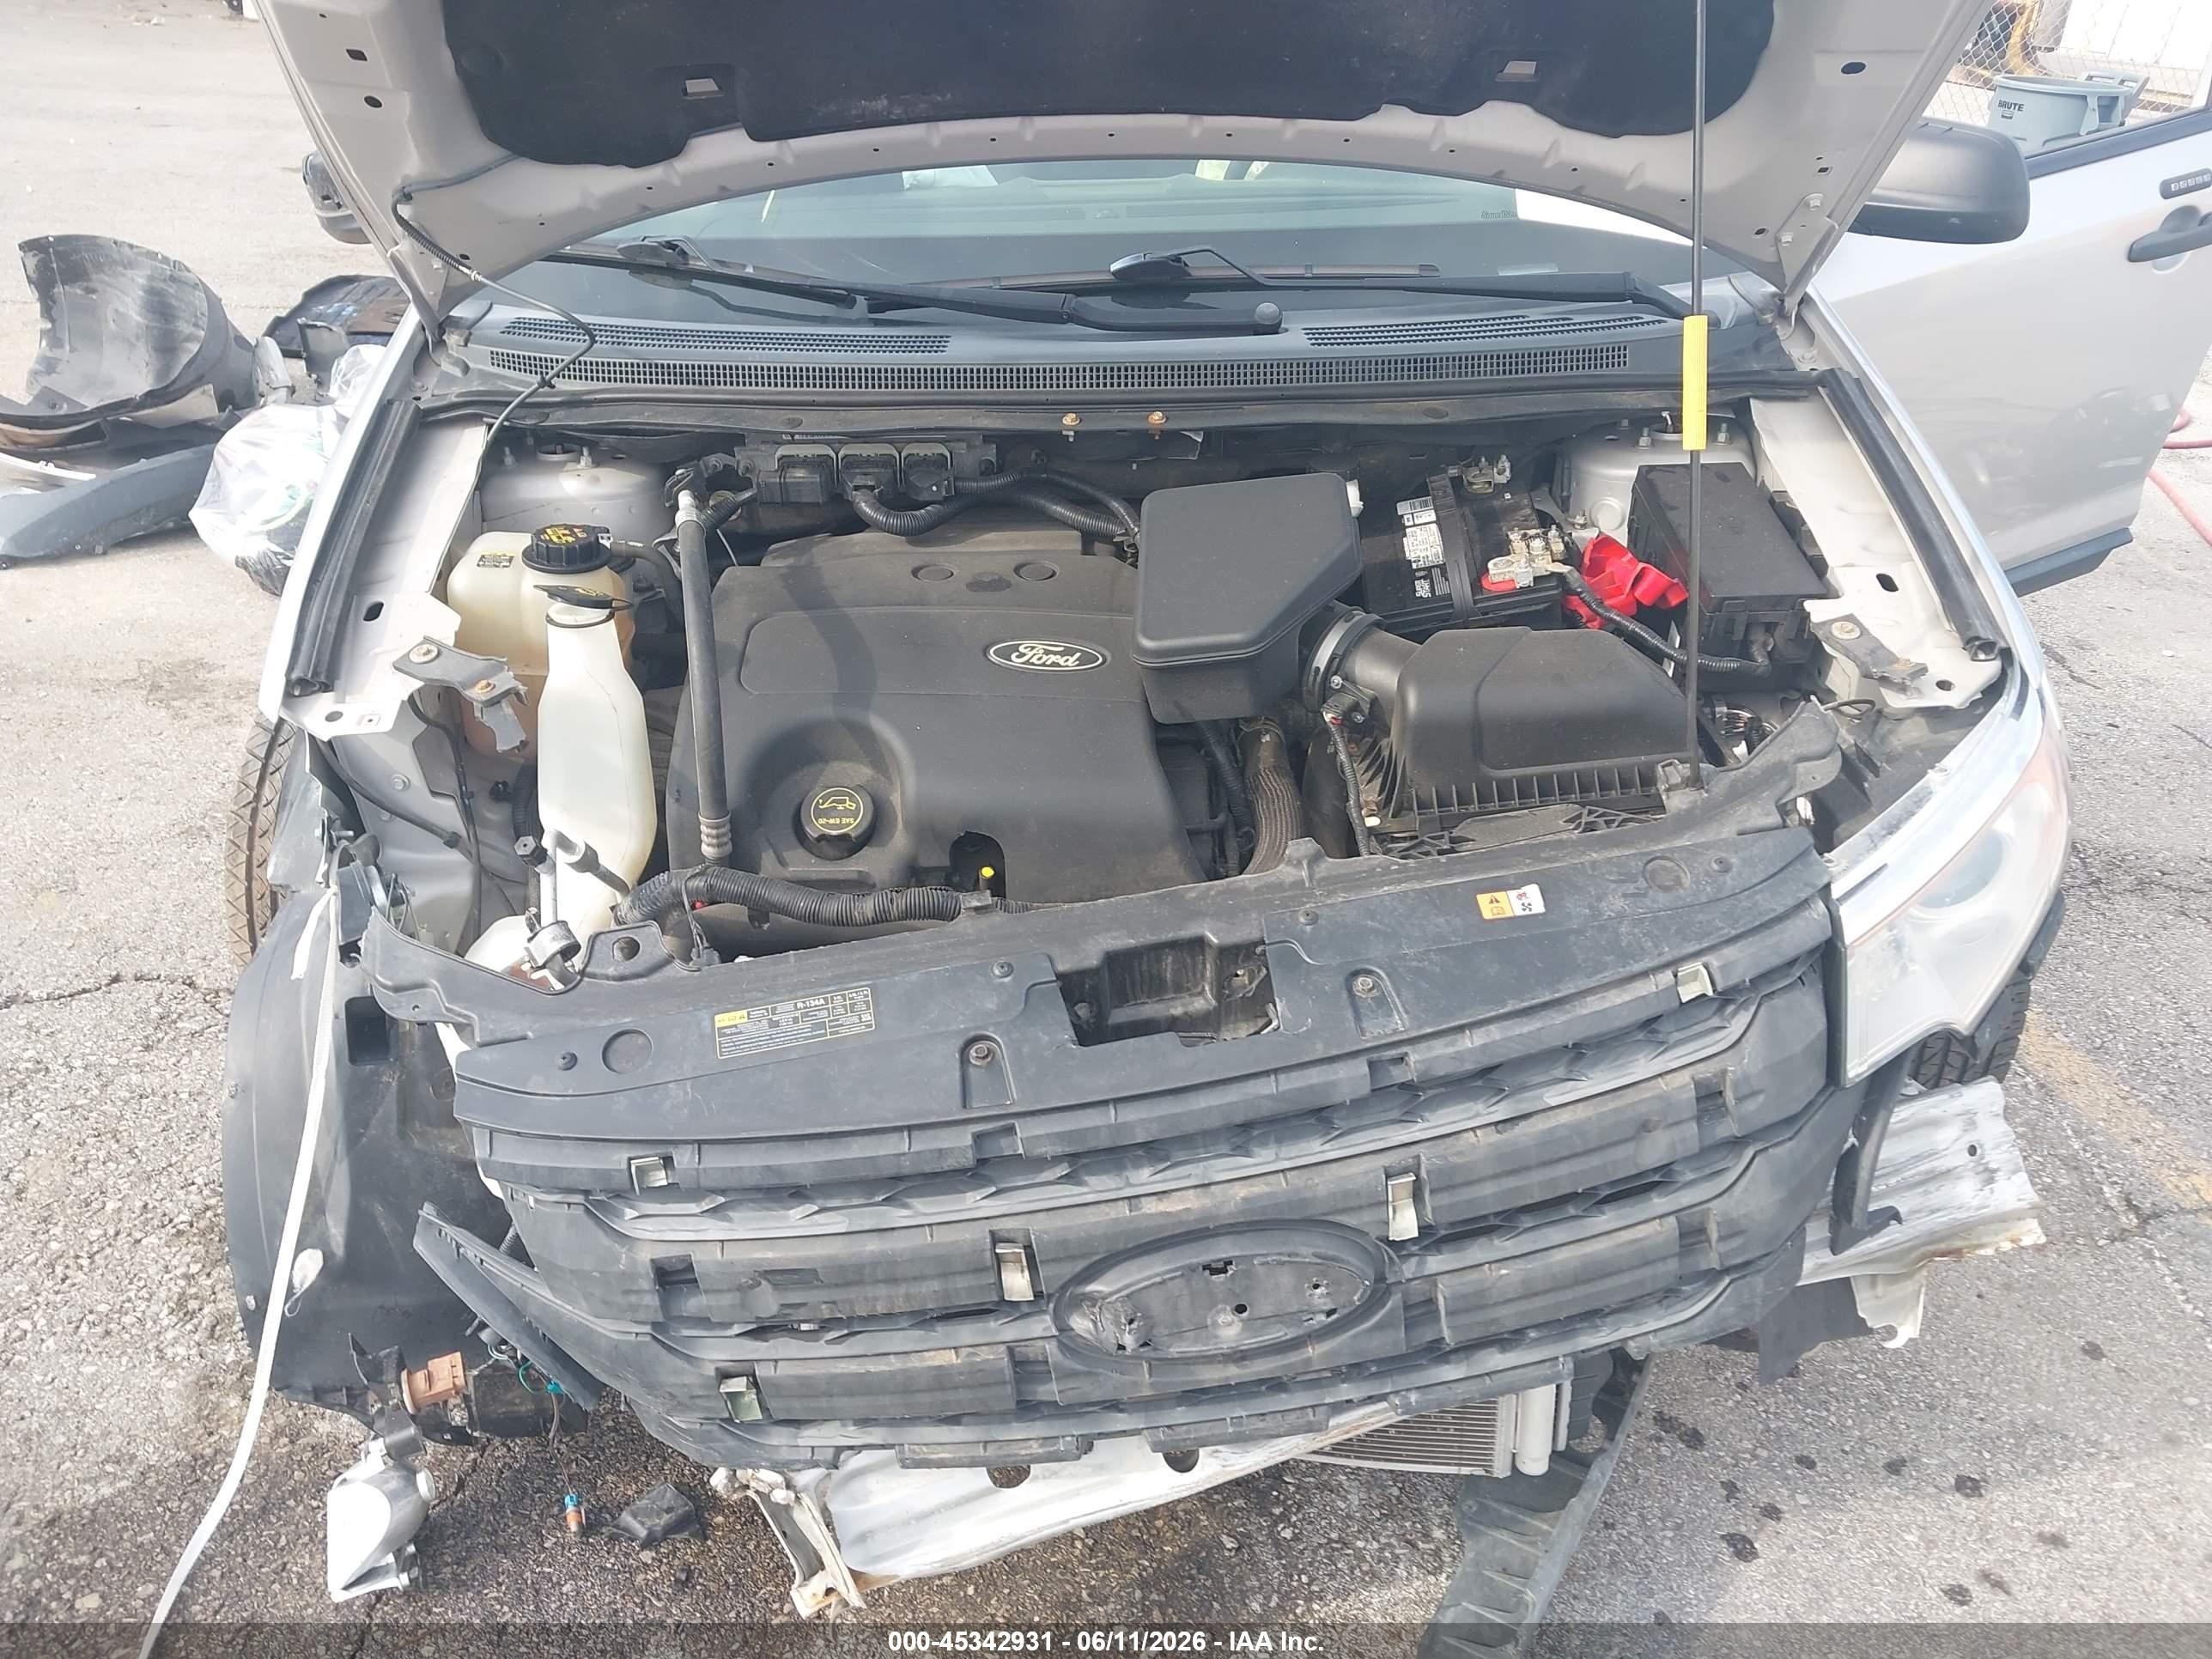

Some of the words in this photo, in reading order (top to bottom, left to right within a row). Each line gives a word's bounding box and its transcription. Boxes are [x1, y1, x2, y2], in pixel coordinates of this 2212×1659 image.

[1997, 99, 2024, 112] BRUTE
[1010, 643, 1082, 666] Ford
[796, 998, 825, 1010] R-134A
